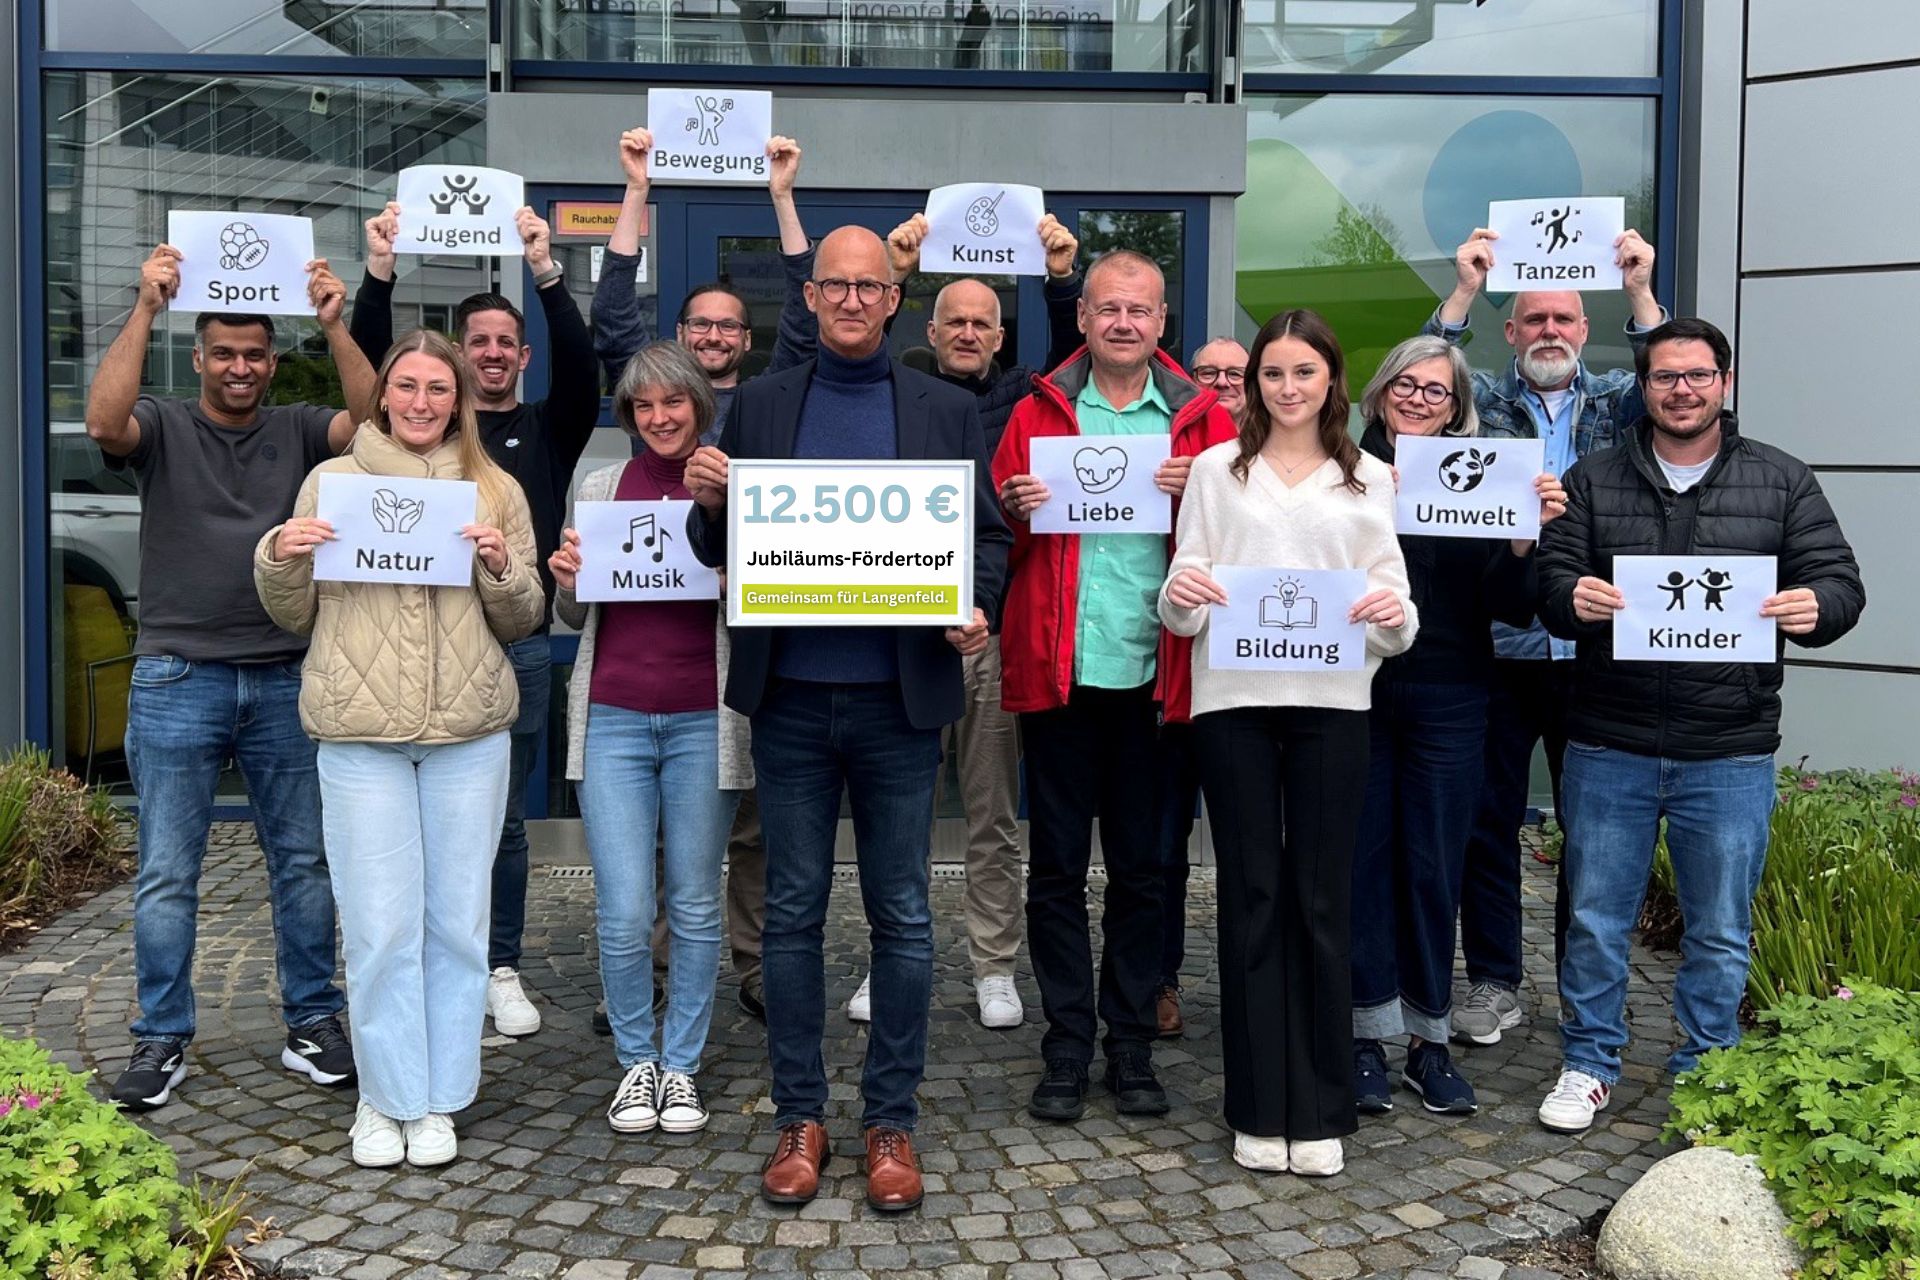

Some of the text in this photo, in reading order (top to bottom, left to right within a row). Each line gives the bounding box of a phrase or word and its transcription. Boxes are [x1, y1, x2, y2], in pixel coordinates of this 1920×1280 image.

[826, 0, 966, 18] Lngenfed
[654, 149, 765, 175] Bewegung
[571, 213, 618, 225] Rauchab
[416, 225, 502, 248] Jugend
[952, 244, 1016, 264] Kunst
[1512, 261, 1597, 280] Tanzen
[207, 280, 280, 306] Sport
[744, 484, 960, 524] 12.500 €
[1068, 502, 1134, 522] Liebe
[1415, 503, 1516, 527] Umwelt
[356, 548, 435, 572] Natur
[746, 550, 955, 571] Jubiläums-Fördertopf
[612, 568, 686, 589] Musik
[746, 591, 949, 607] Gemeinsam für Langenfeld.
[1649, 627, 1742, 649] Kinder
[1236, 638, 1340, 665] Bildung
